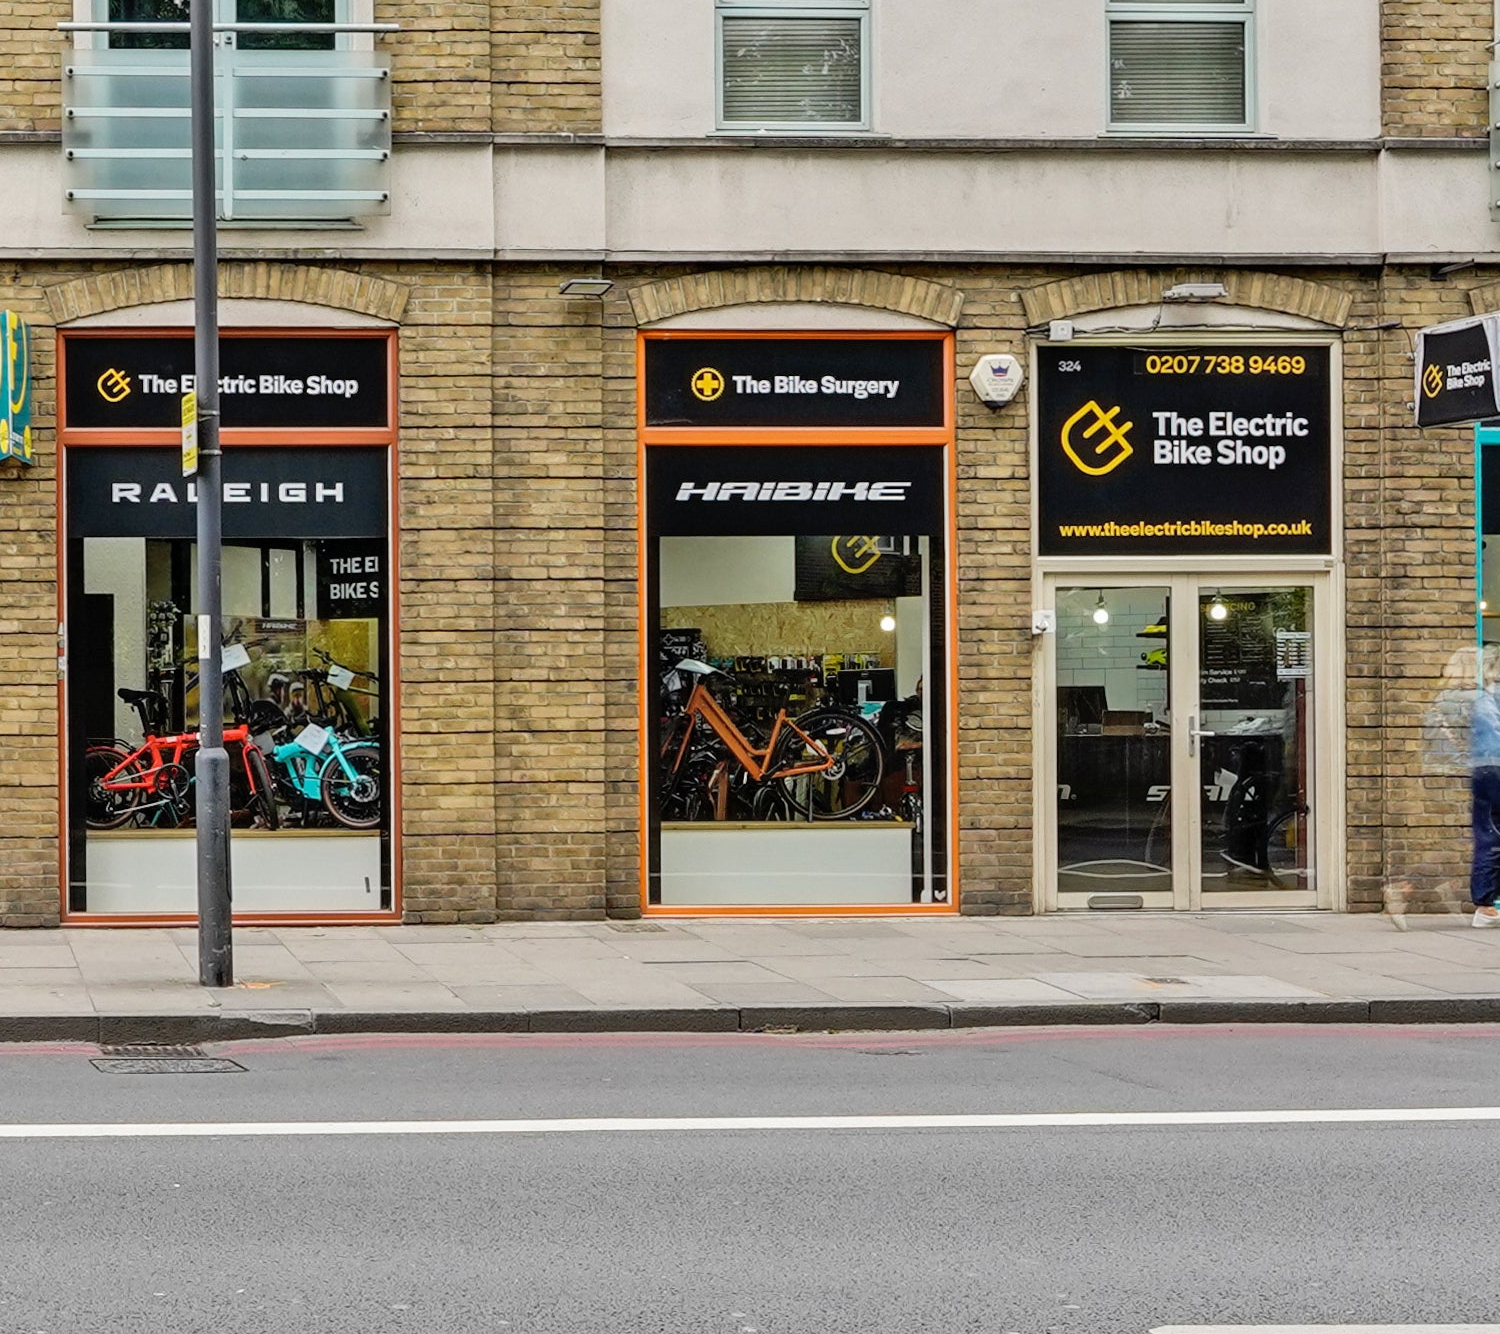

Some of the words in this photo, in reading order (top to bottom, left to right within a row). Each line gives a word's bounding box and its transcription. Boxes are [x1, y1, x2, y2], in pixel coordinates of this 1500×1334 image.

[1058, 361, 1081, 372] 324
[1146, 355, 1200, 374] 0207
[1204, 355, 1245, 374] 738
[1248, 355, 1306, 374] 9469
[1446, 365, 1461, 377] The
[1462, 359, 1490, 375] Electric
[138, 374, 177, 394] The
[181, 374, 256, 394] Eltric
[259, 375, 304, 395] Bike
[306, 375, 358, 397] Shop
[732, 375, 772, 394] The
[774, 375, 818, 394] Bike
[820, 375, 899, 399] Surgery
[1446, 377, 1463, 390] Bike
[1464, 375, 1485, 387] Shop
[1152, 412, 1204, 436] The
[1209, 412, 1308, 436] Electric
[1154, 440, 1212, 465] Bike
[1216, 439, 1286, 469] Shop
[675, 482, 912, 501] HAIBIKE
[1059, 521, 1312, 538] www.theelectricbikeshop.co.uk
[330, 557, 362, 575] THE
[330, 582, 366, 599] BIKE
